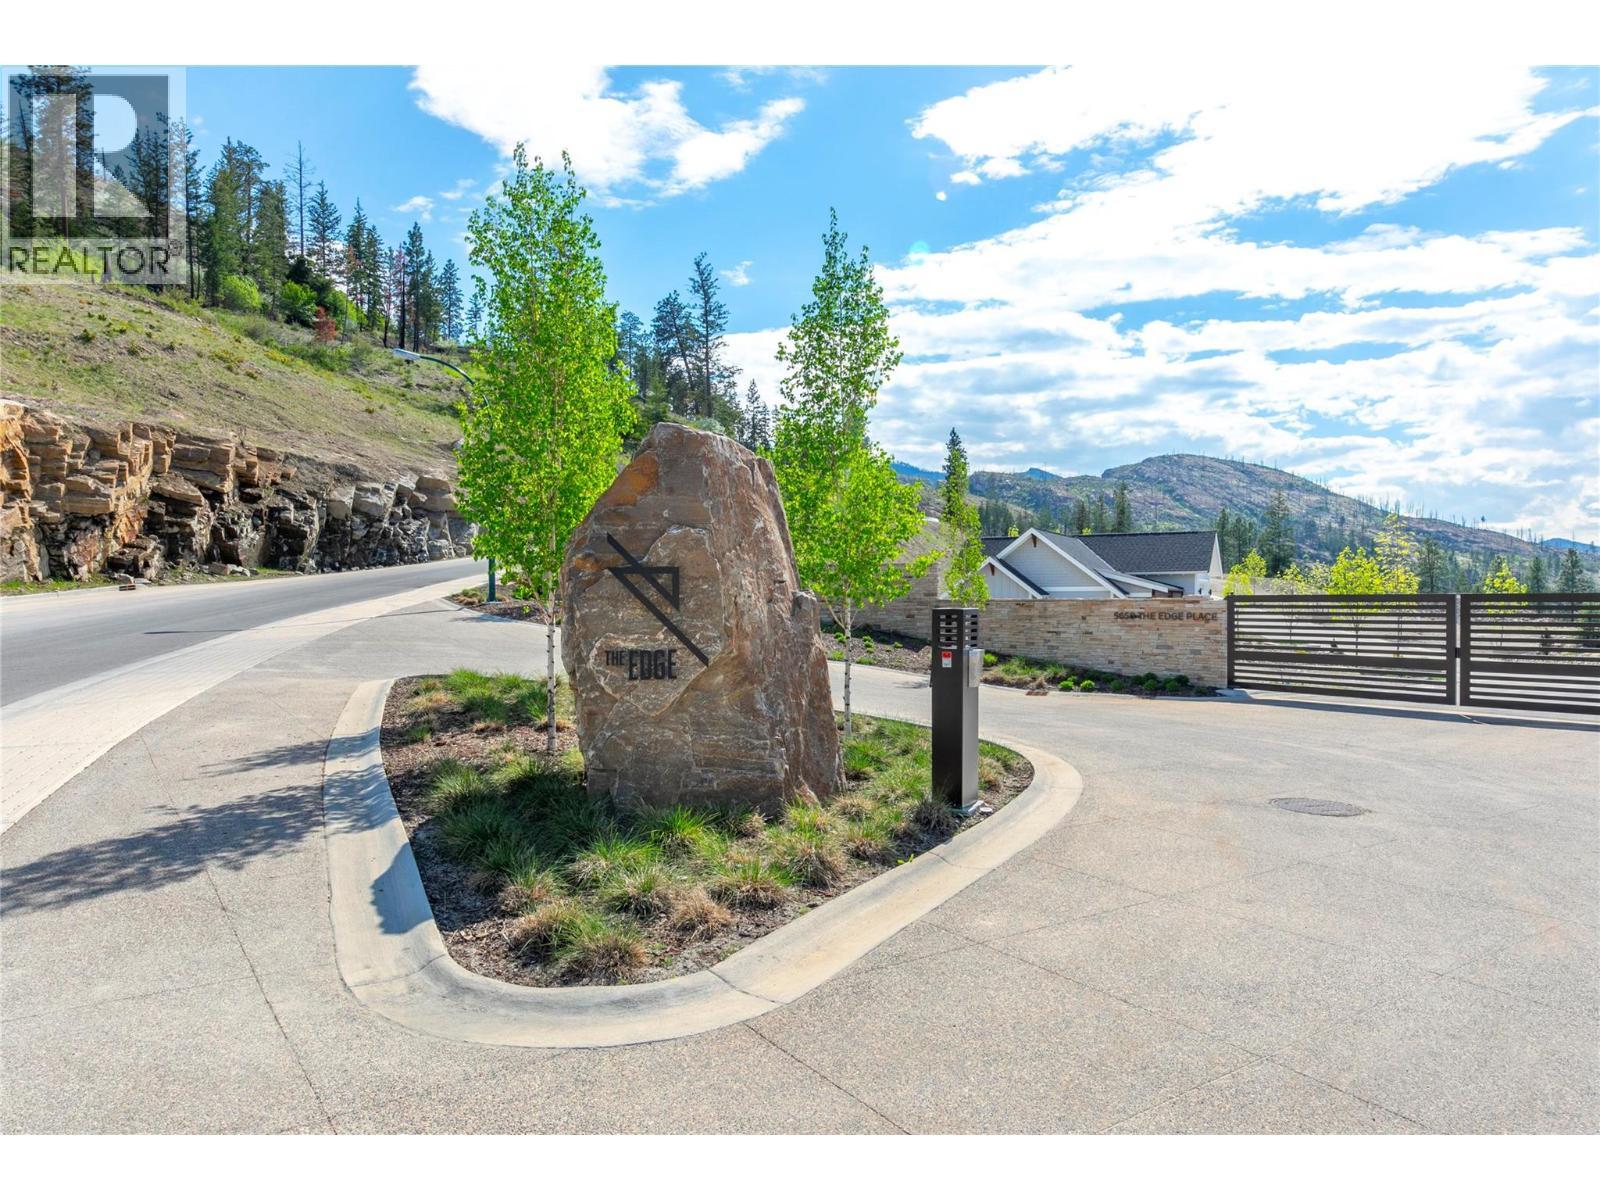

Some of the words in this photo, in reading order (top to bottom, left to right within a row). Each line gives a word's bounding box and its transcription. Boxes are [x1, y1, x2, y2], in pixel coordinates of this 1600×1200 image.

[1137, 611, 1157, 621] THE
[1158, 611, 1184, 621] EDGE
[1186, 611, 1218, 621] PLACE
[604, 650, 625, 666] THE
[628, 649, 678, 681] EDGE
